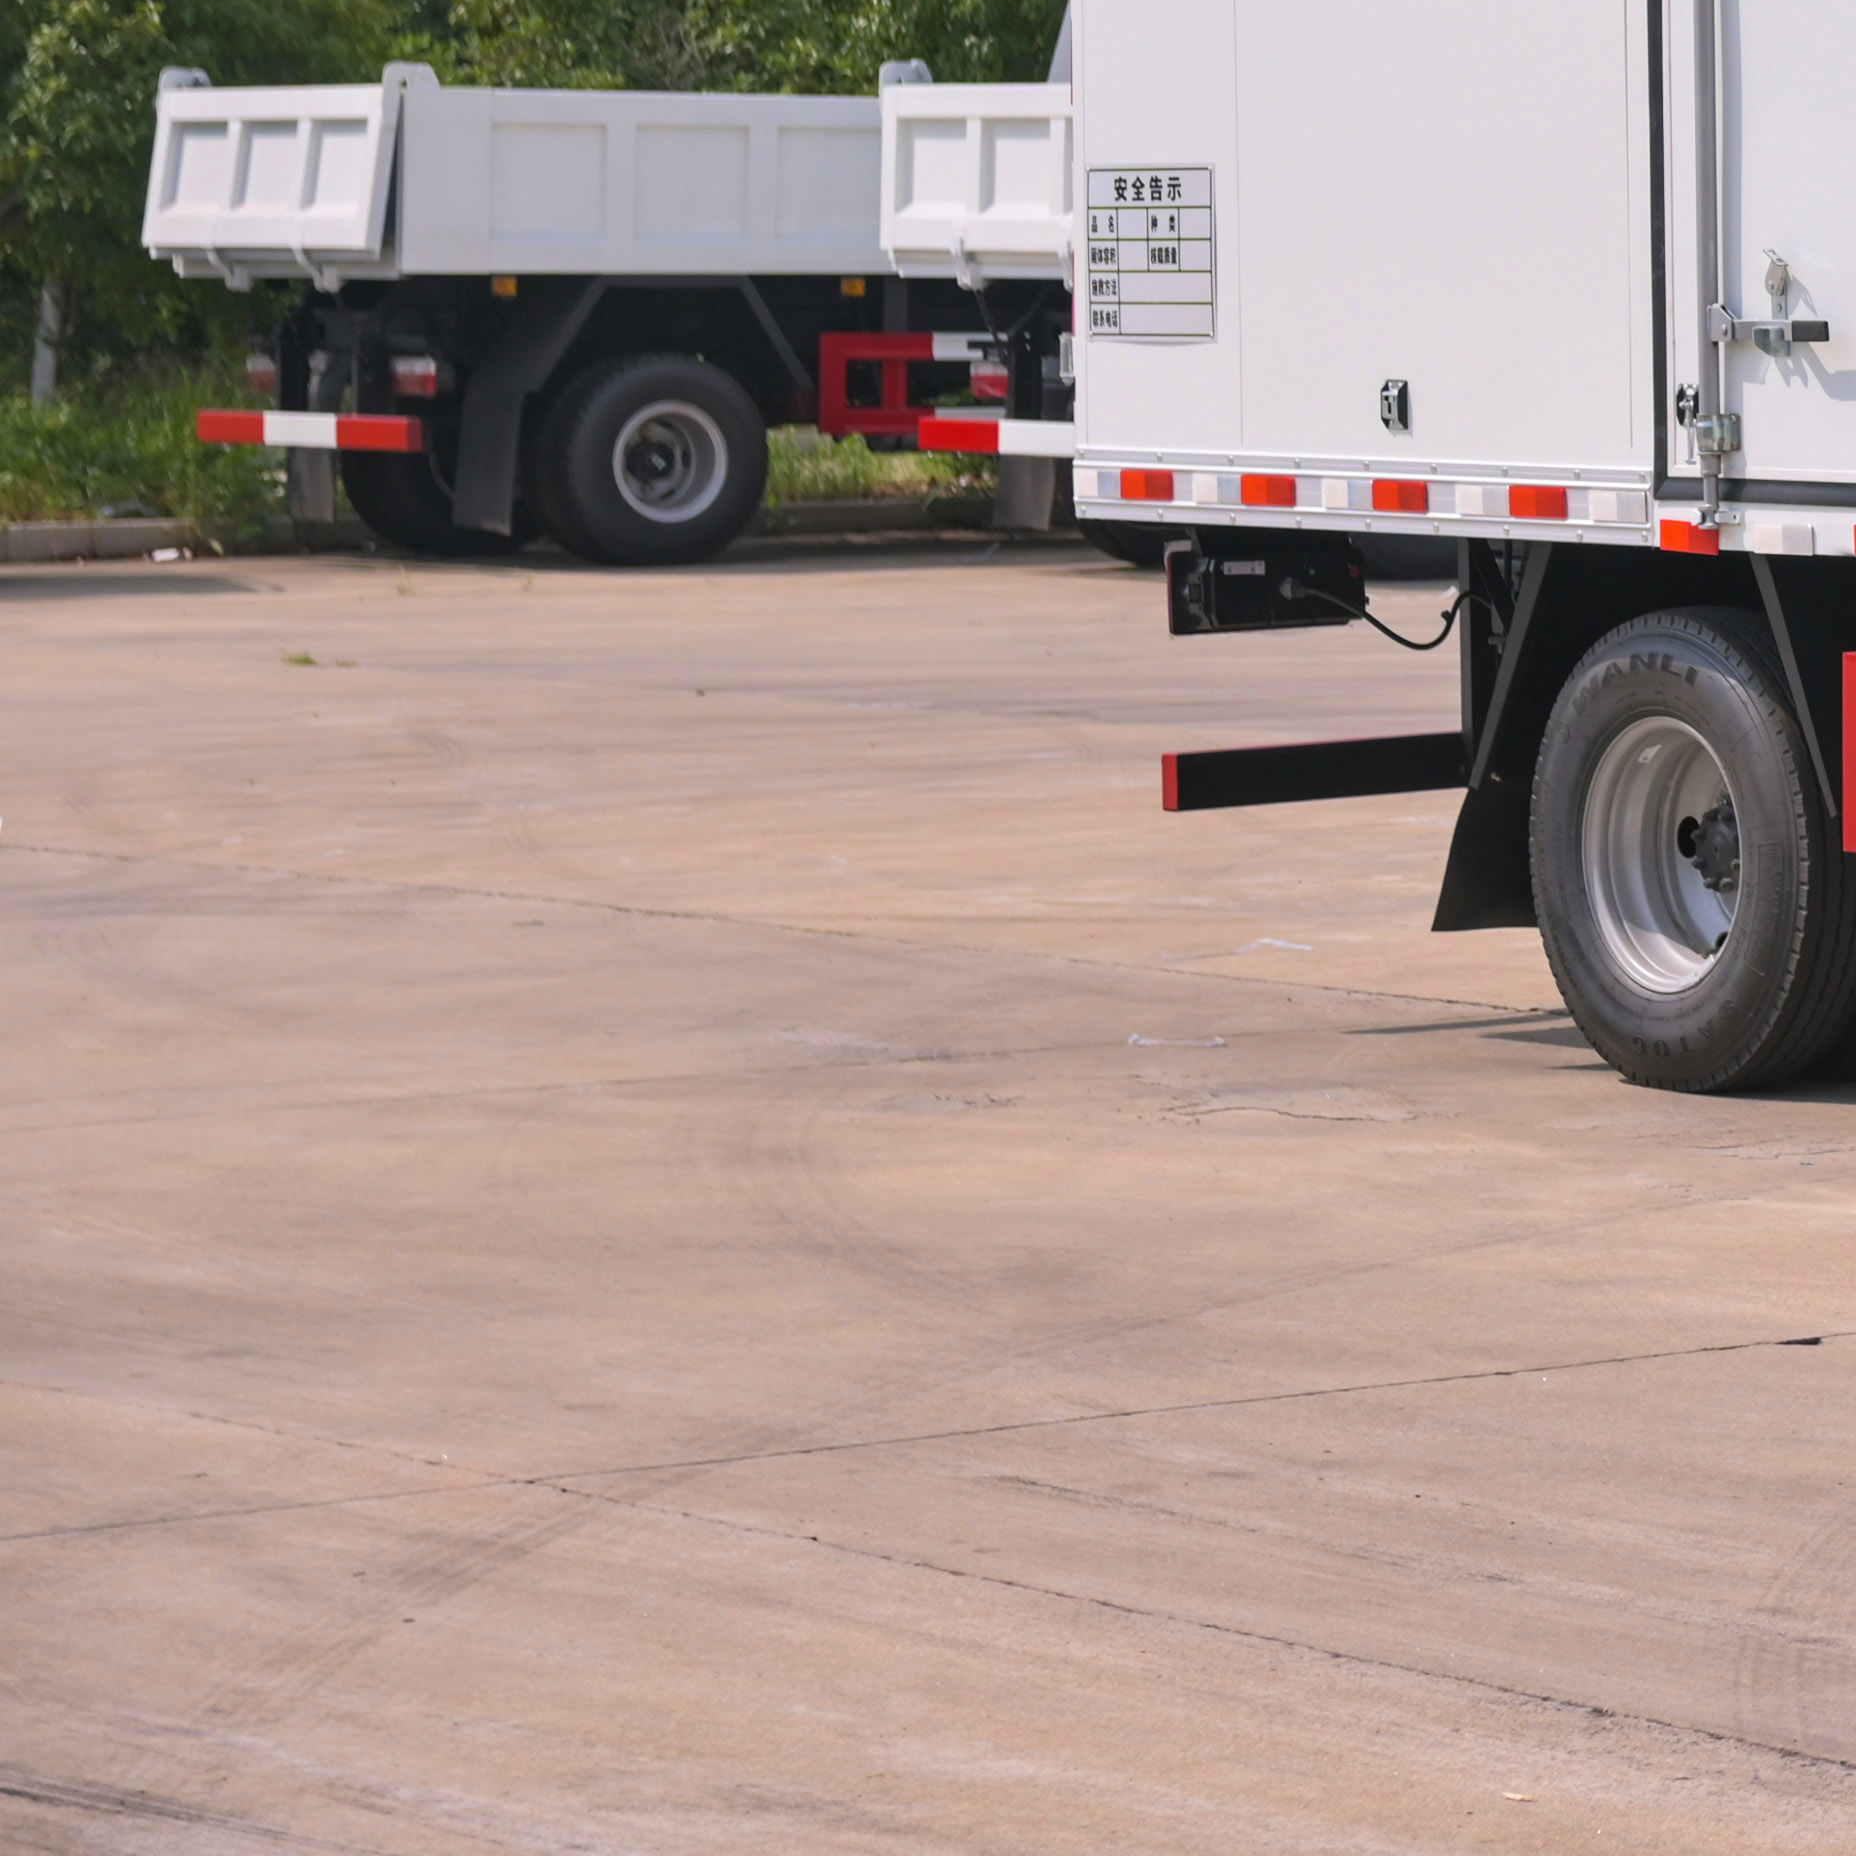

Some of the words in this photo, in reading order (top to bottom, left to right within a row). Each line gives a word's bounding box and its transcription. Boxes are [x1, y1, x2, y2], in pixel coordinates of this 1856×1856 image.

[1114, 175, 1182, 202] 安全告示
[1571, 651, 1700, 717] WANLI
